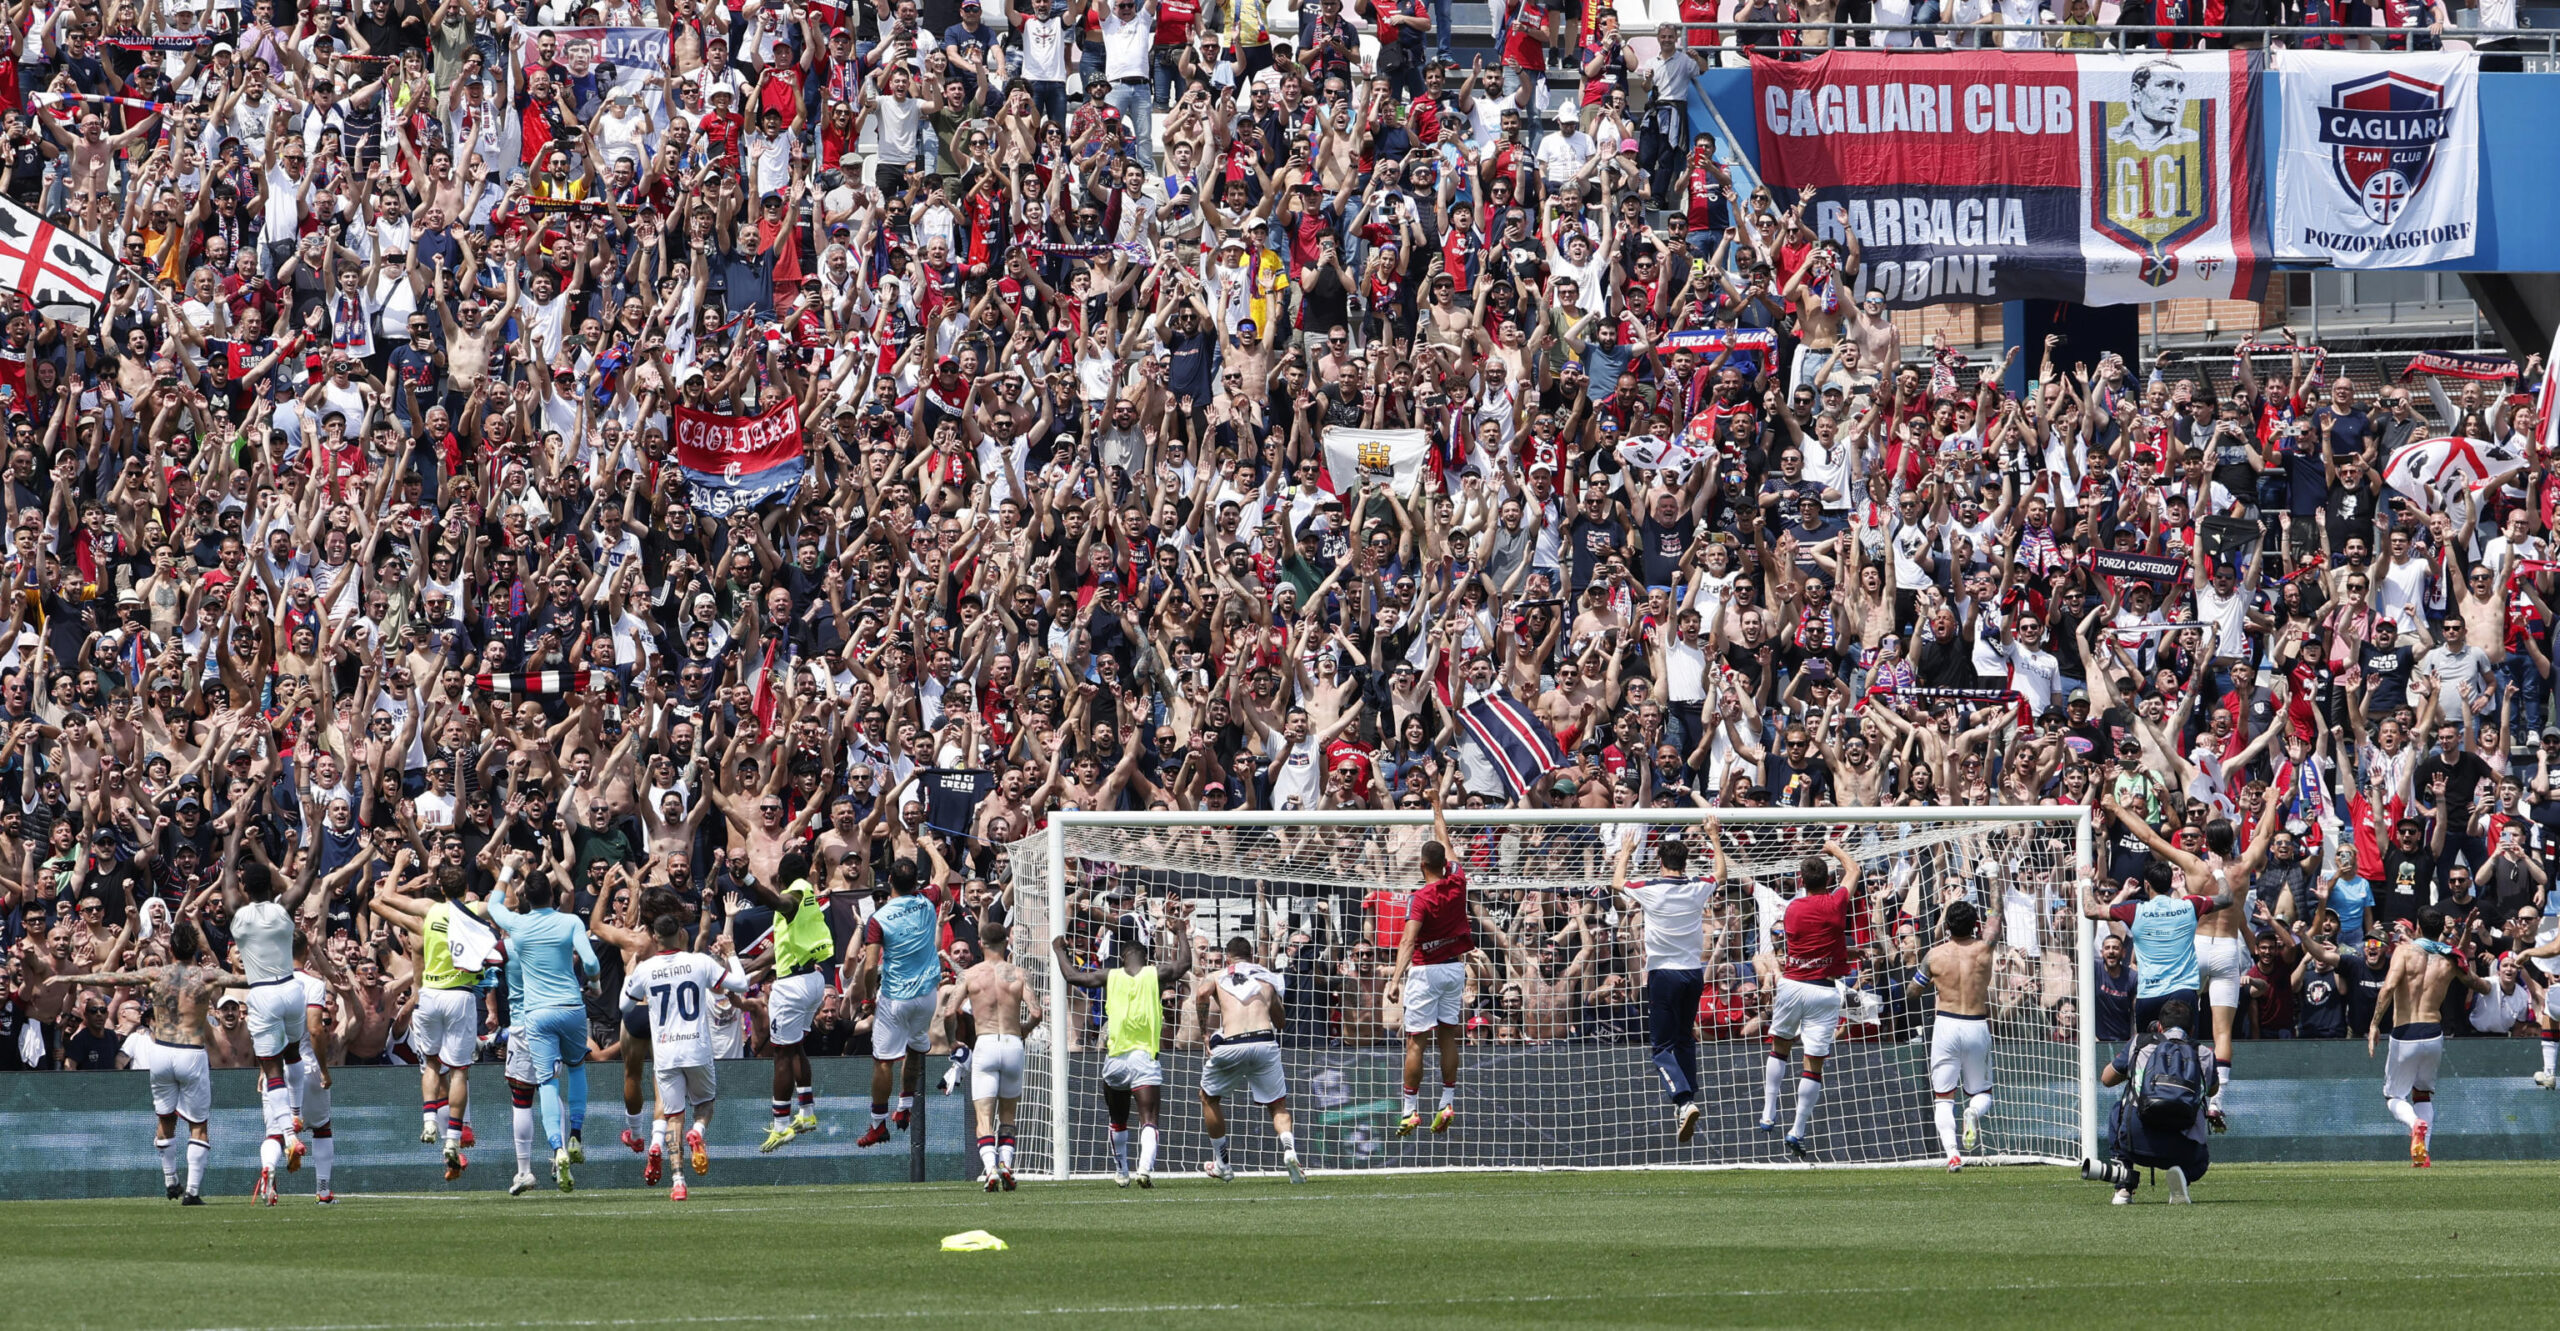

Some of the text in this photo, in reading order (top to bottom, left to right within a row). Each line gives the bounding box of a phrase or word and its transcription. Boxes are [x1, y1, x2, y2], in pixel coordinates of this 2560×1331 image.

[158, 37, 193, 46] CALCIO
[1764, 83, 2073, 136] CAGLIARI CLUB
[2357, 151, 2422, 163] FAN CLUB
[1817, 197, 2028, 246] BARBAGIA
[1672, 335, 1715, 347] FORZA
[2416, 352, 2459, 371] FORZA
[680, 406, 797, 453] CAGLIARI
[2097, 556, 2178, 576] FORZA CASTEDDU
[941, 780, 975, 790] CREDO
[2142, 908, 2188, 918] CASEDDU
[651, 964, 693, 980] GAETANO
[650, 980, 700, 1026] 70
[770, 1018, 778, 1034] 4
